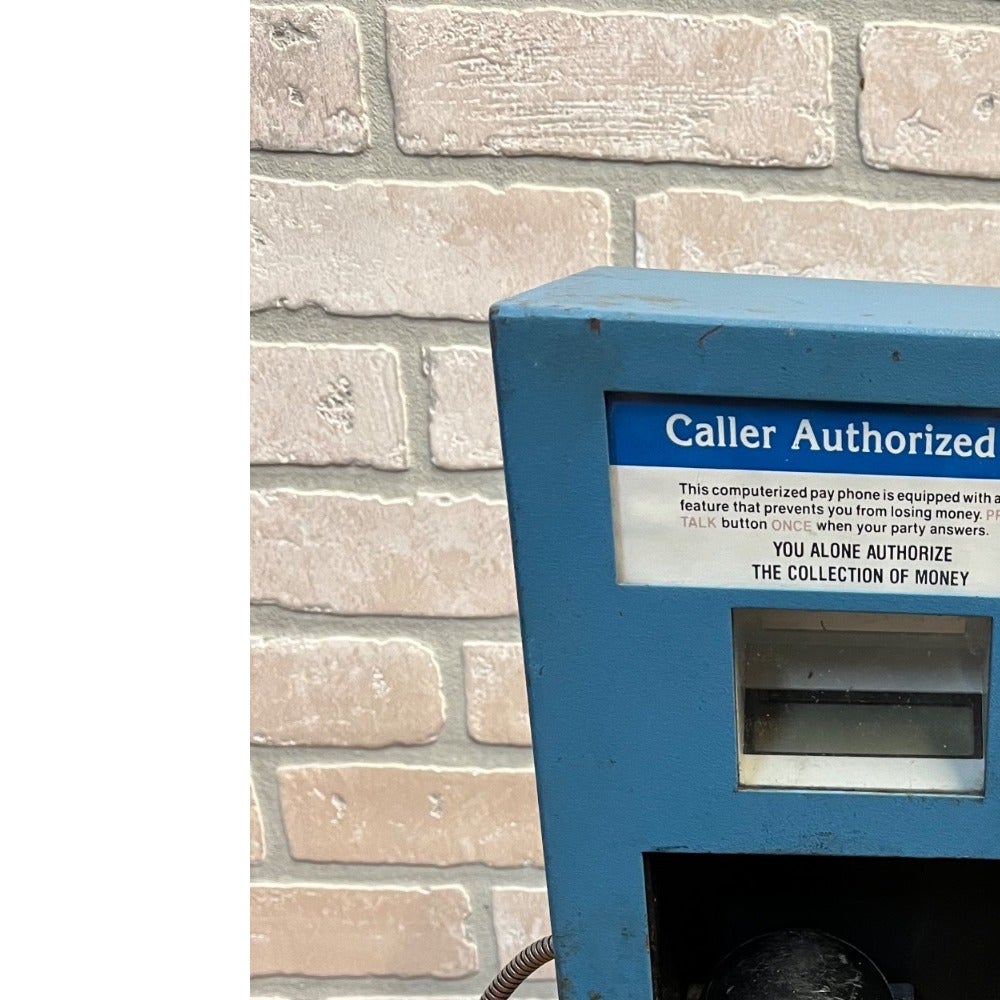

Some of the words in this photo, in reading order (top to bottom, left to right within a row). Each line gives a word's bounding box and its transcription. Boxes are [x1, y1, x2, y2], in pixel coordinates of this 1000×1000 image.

[665, 413, 776, 449] Caller
[790, 418, 996, 458] Authorized
[679, 482, 709, 496] This
[712, 485, 807, 499] computerized
[810, 490, 835, 500] pay
[838, 488, 880, 501] phone
[883, 489, 894, 501] is
[897, 490, 960, 504] equipped
[963, 492, 991, 503] with
[994, 495, 1000, 504] a
[680, 499, 729, 512] feature
[733, 501, 760, 513] that
[764, 503, 824, 516] prevents
[828, 505, 852, 518] you
[856, 504, 887, 517] from
[891, 506, 932, 521] losing
[935, 509, 982, 522] money.
[681, 517, 717, 528] TALK
[722, 517, 767, 530] button
[772, 519, 812, 532] ONCE
[817, 520, 852, 532] when
[857, 521, 887, 535] your
[891, 523, 926, 536] party
[930, 525, 989, 536] answers.
[773, 541, 804, 558] YOU
[810, 543, 861, 559] ALONE
[867, 544, 952, 562] AUTHORIZE
[752, 564, 781, 580] THE
[788, 565, 883, 583] COLLECTION
[890, 568, 909, 584] OF
[915, 569, 969, 586] MONEY
